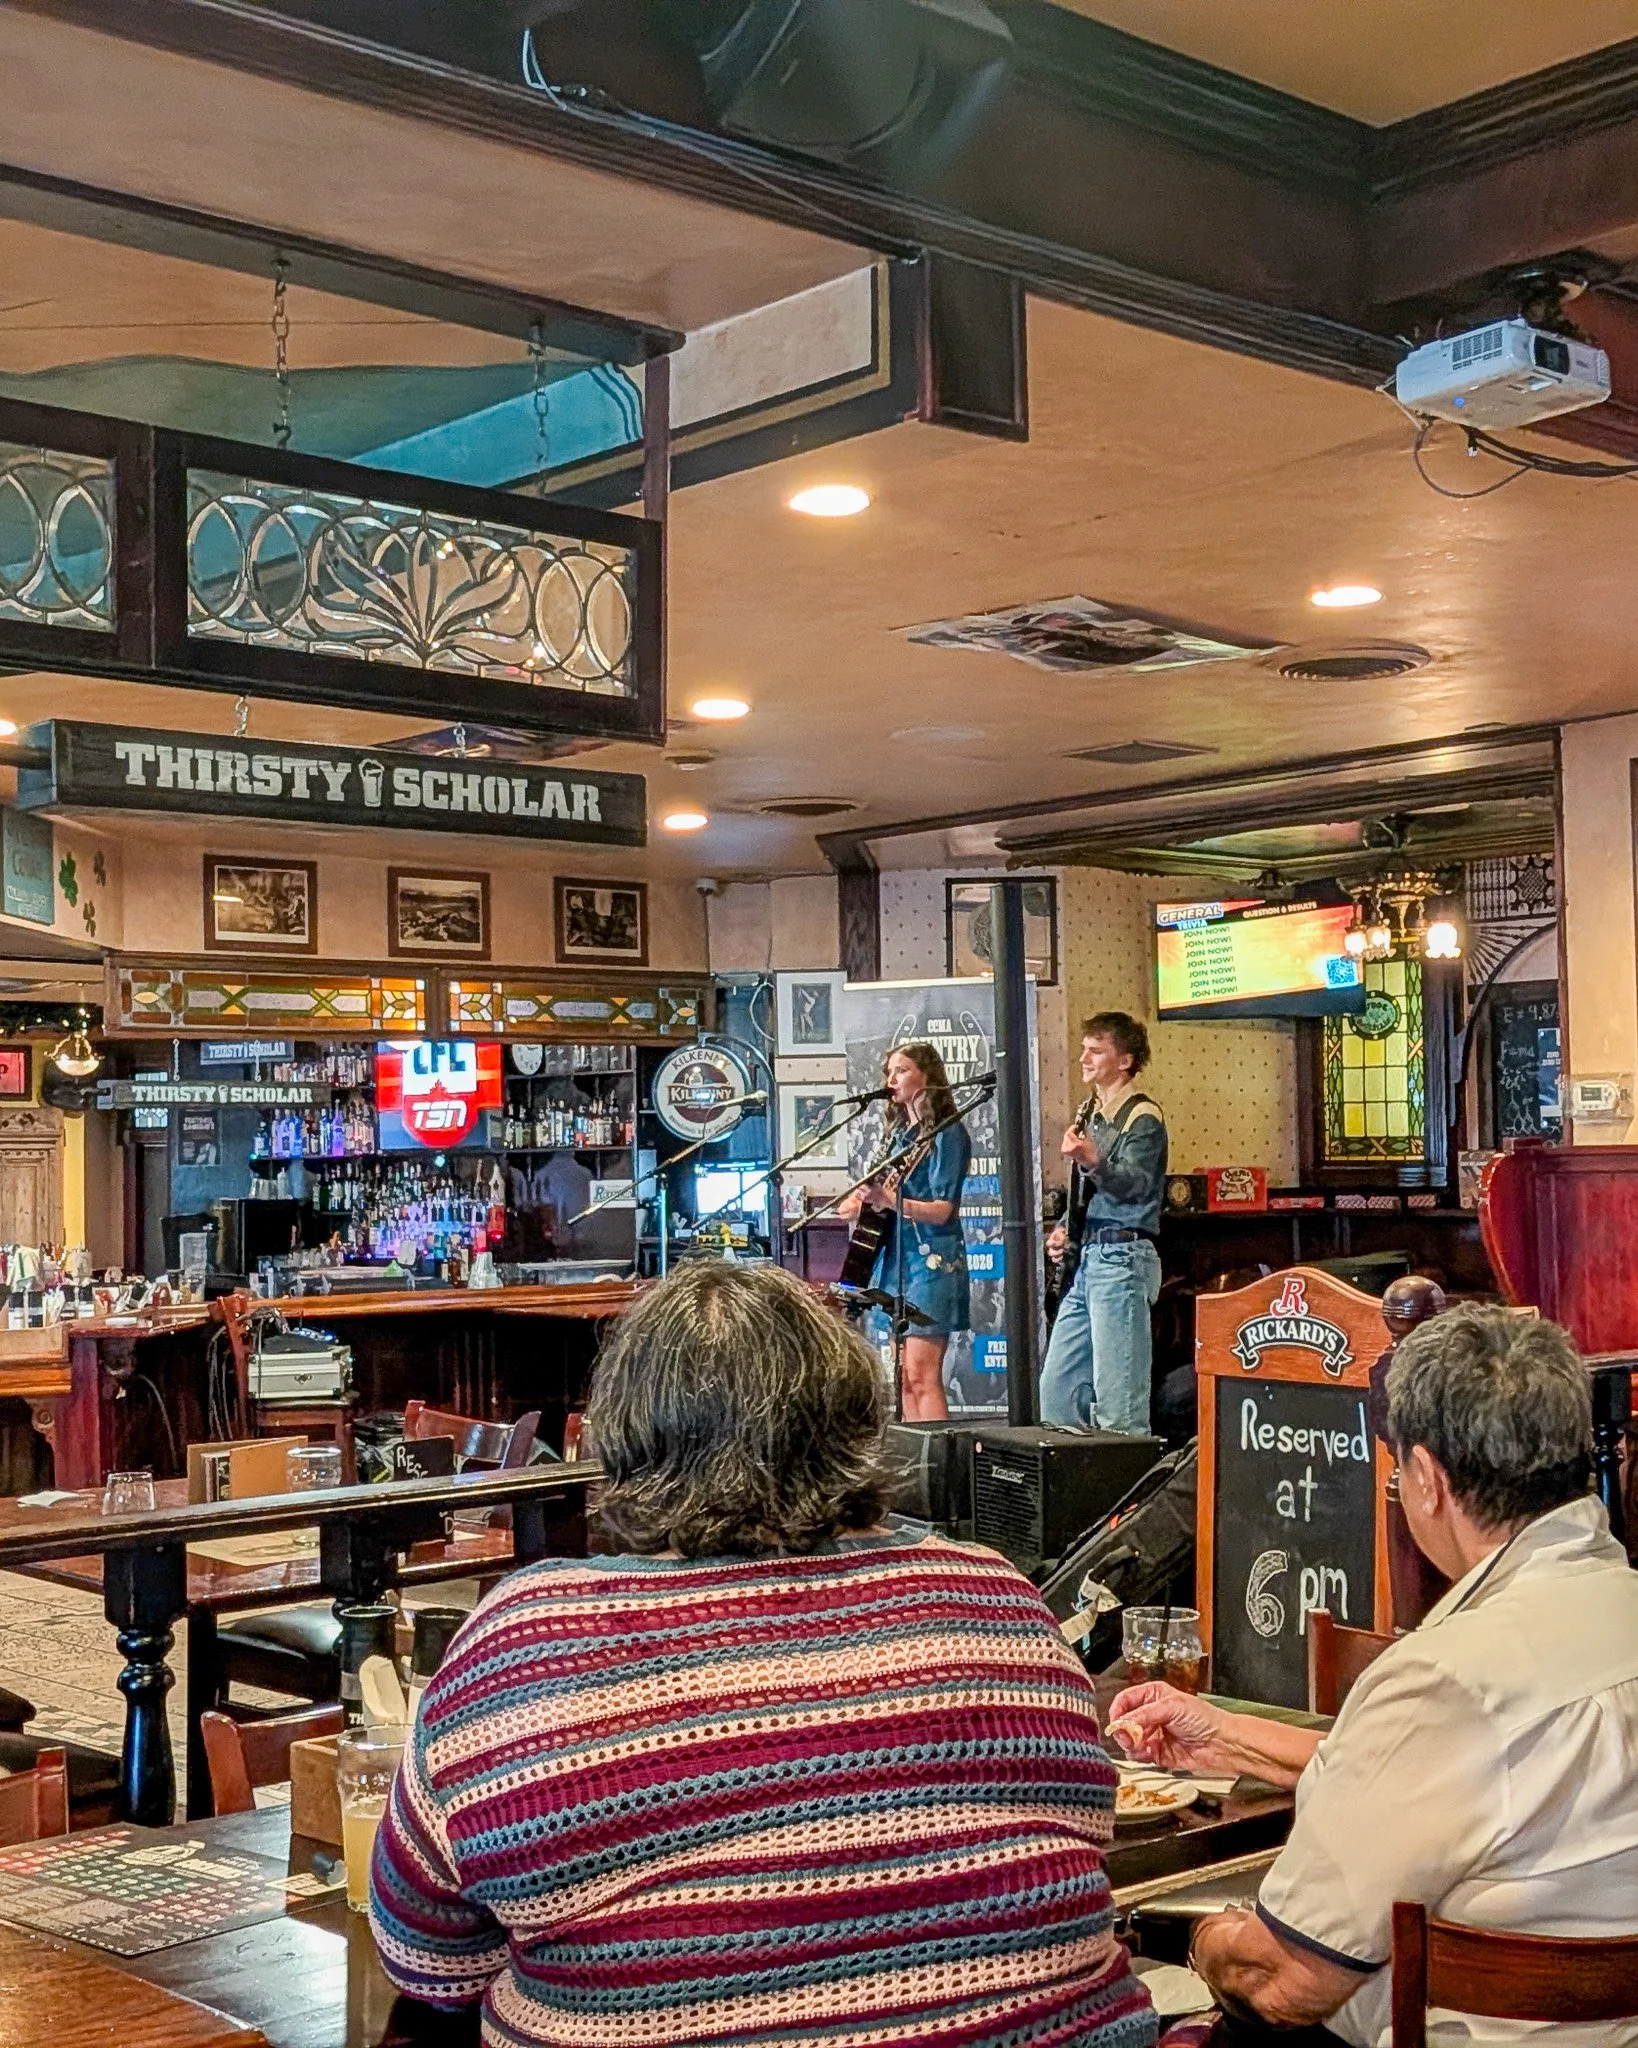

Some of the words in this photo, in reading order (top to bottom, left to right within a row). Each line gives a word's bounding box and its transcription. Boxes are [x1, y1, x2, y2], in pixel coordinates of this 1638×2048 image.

[115, 741, 352, 802] THIRSTY
[392, 767, 602, 822] SCHOLAR
[1160, 904, 1221, 924] GENERAL
[1242, 906, 1280, 919] QUESTION
[1287, 900, 1318, 913] RESULTS
[1177, 919, 1209, 931] TRIVIA
[1184, 930, 1203, 939] JOIN
[1185, 940, 1204, 949] JOIN
[1186, 949, 1205, 959] JOIN
[1187, 960, 1207, 968] JOIN
[1189, 969, 1208, 978] JOIN
[1190, 980, 1209, 989] JOIN
[1191, 989, 1211, 998] JOIN
[927, 1019, 953, 1033] CCMA
[900, 1035, 980, 1062] NTRY
[671, 1050, 731, 1072] KILKENNY
[131, 1085, 216, 1104] THIRSTY
[230, 1086, 313, 1104] SCHOLAR
[412, 1099, 468, 1129] TSN
[1270, 1278, 1308, 1318] R
[1245, 1320, 1339, 1352] RICKARD'S
[987, 1340, 1007, 1354] FRE
[1241, 1398, 1369, 1466] Reserved
[1276, 1465, 1319, 1523] at
[1246, 1549, 1288, 1638] 6
[1298, 1565, 1348, 1637] pm
